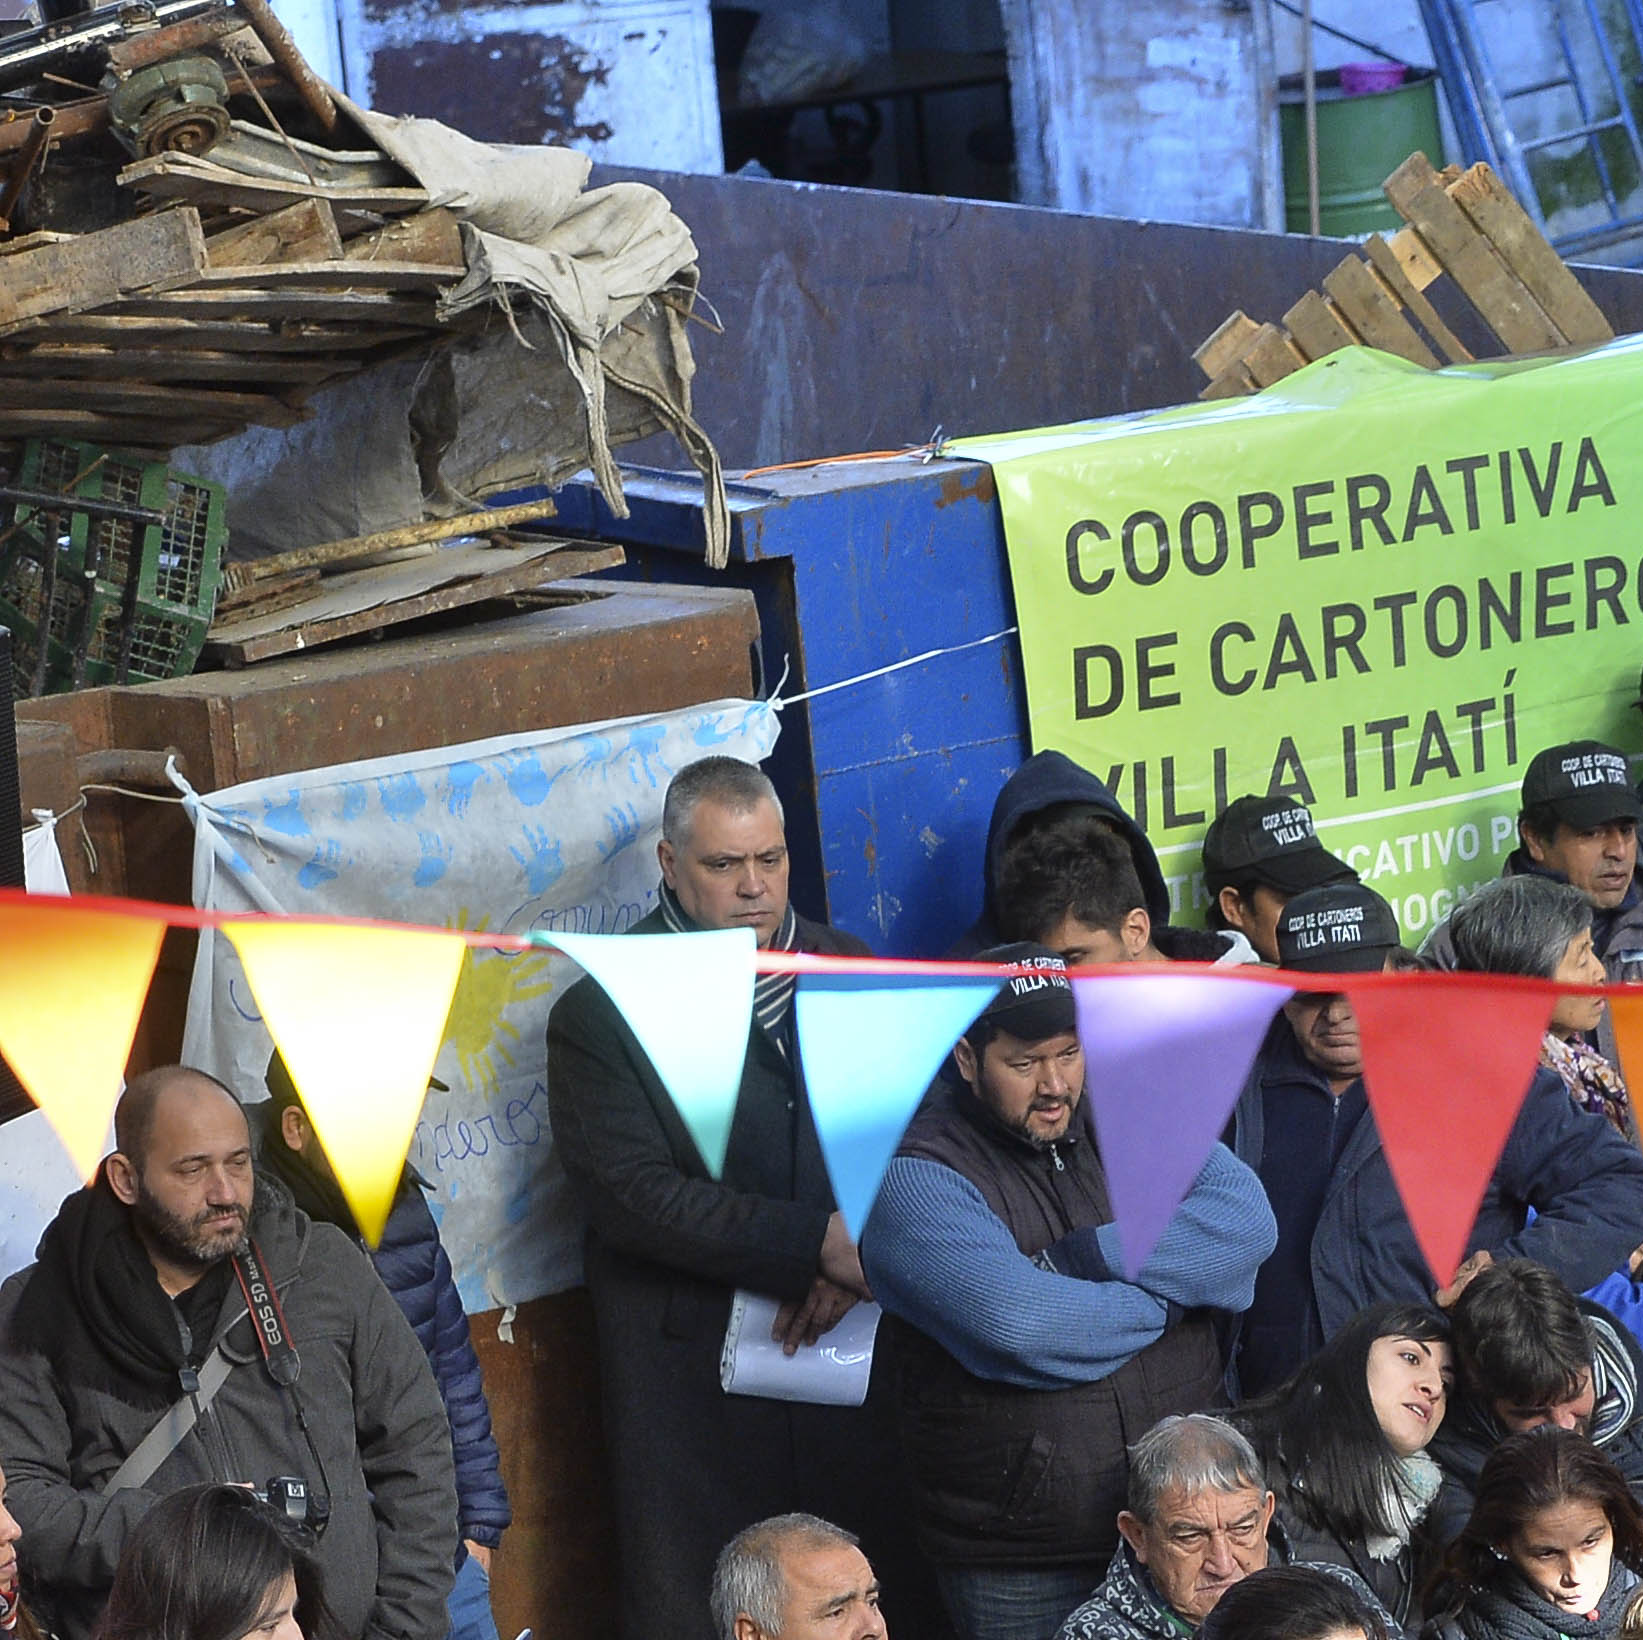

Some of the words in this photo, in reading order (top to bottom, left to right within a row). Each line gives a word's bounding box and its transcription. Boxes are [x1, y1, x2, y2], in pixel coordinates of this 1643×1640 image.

[1066, 437, 1616, 596] COOPERATIVA
[1073, 631, 1181, 721] DE
[1341, 669, 1519, 799] ITATÍ
[1273, 823, 1306, 846] VILLA
[1332, 822, 1481, 882] CATIVO
[1331, 924, 1361, 942] ITATI
[1010, 974, 1048, 996] VILLA
[250, 1282, 268, 1303] 5D
[259, 1305, 282, 1345] EOS
